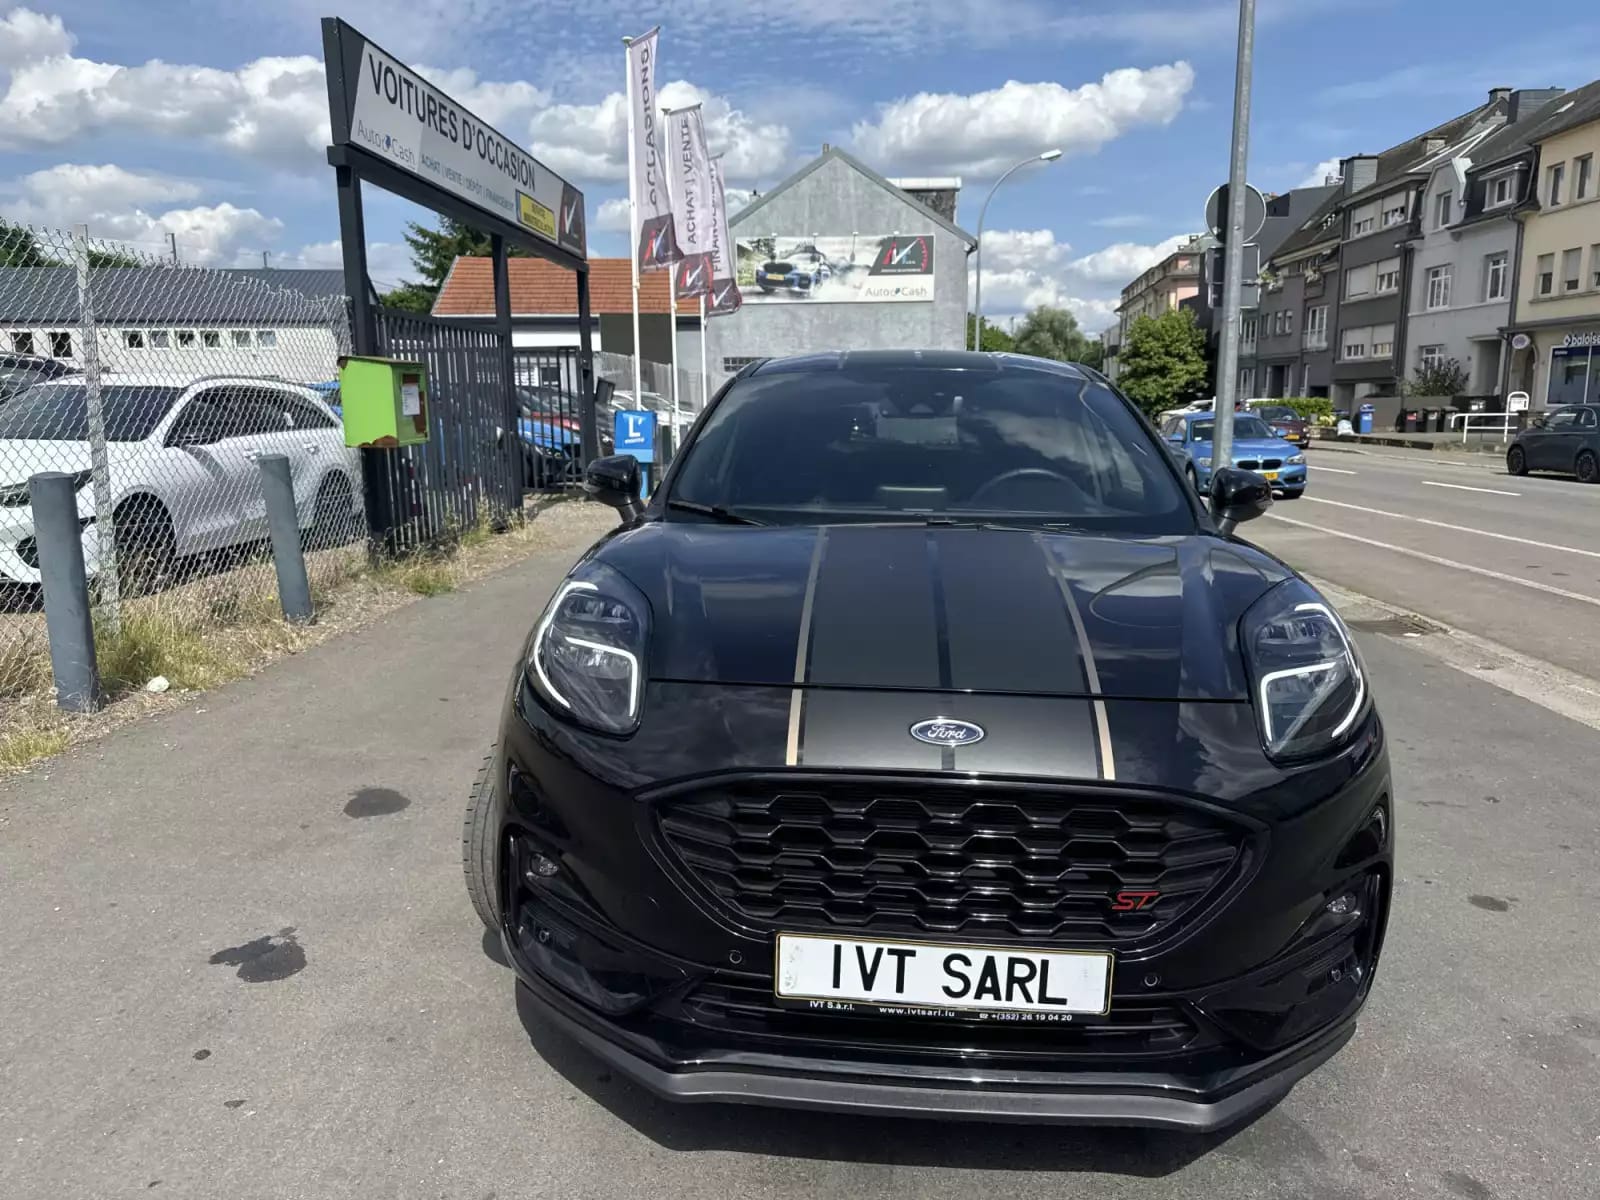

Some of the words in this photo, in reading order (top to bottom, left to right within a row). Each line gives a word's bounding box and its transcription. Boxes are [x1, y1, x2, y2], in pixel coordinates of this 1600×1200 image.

[369, 53, 458, 144] VOITURES
[463, 119, 536, 192] D'OCCASION
[681, 119, 693, 175] VENTE
[685, 189, 697, 245] ACHAT
[927, 723, 967, 739] Ford
[1111, 890, 1160, 910] ST
[832, 944, 916, 995] IVT
[941, 953, 1068, 1005] SARL
[809, 1000, 825, 1009] IVT
[879, 1006, 955, 1018] www.ivtsarl.lu
[1021, 1013, 1033, 1021] 26
[1035, 1014, 1046, 1022] 19
[1047, 1014, 1059, 1022] 04
[1060, 1014, 1073, 1022] 20
